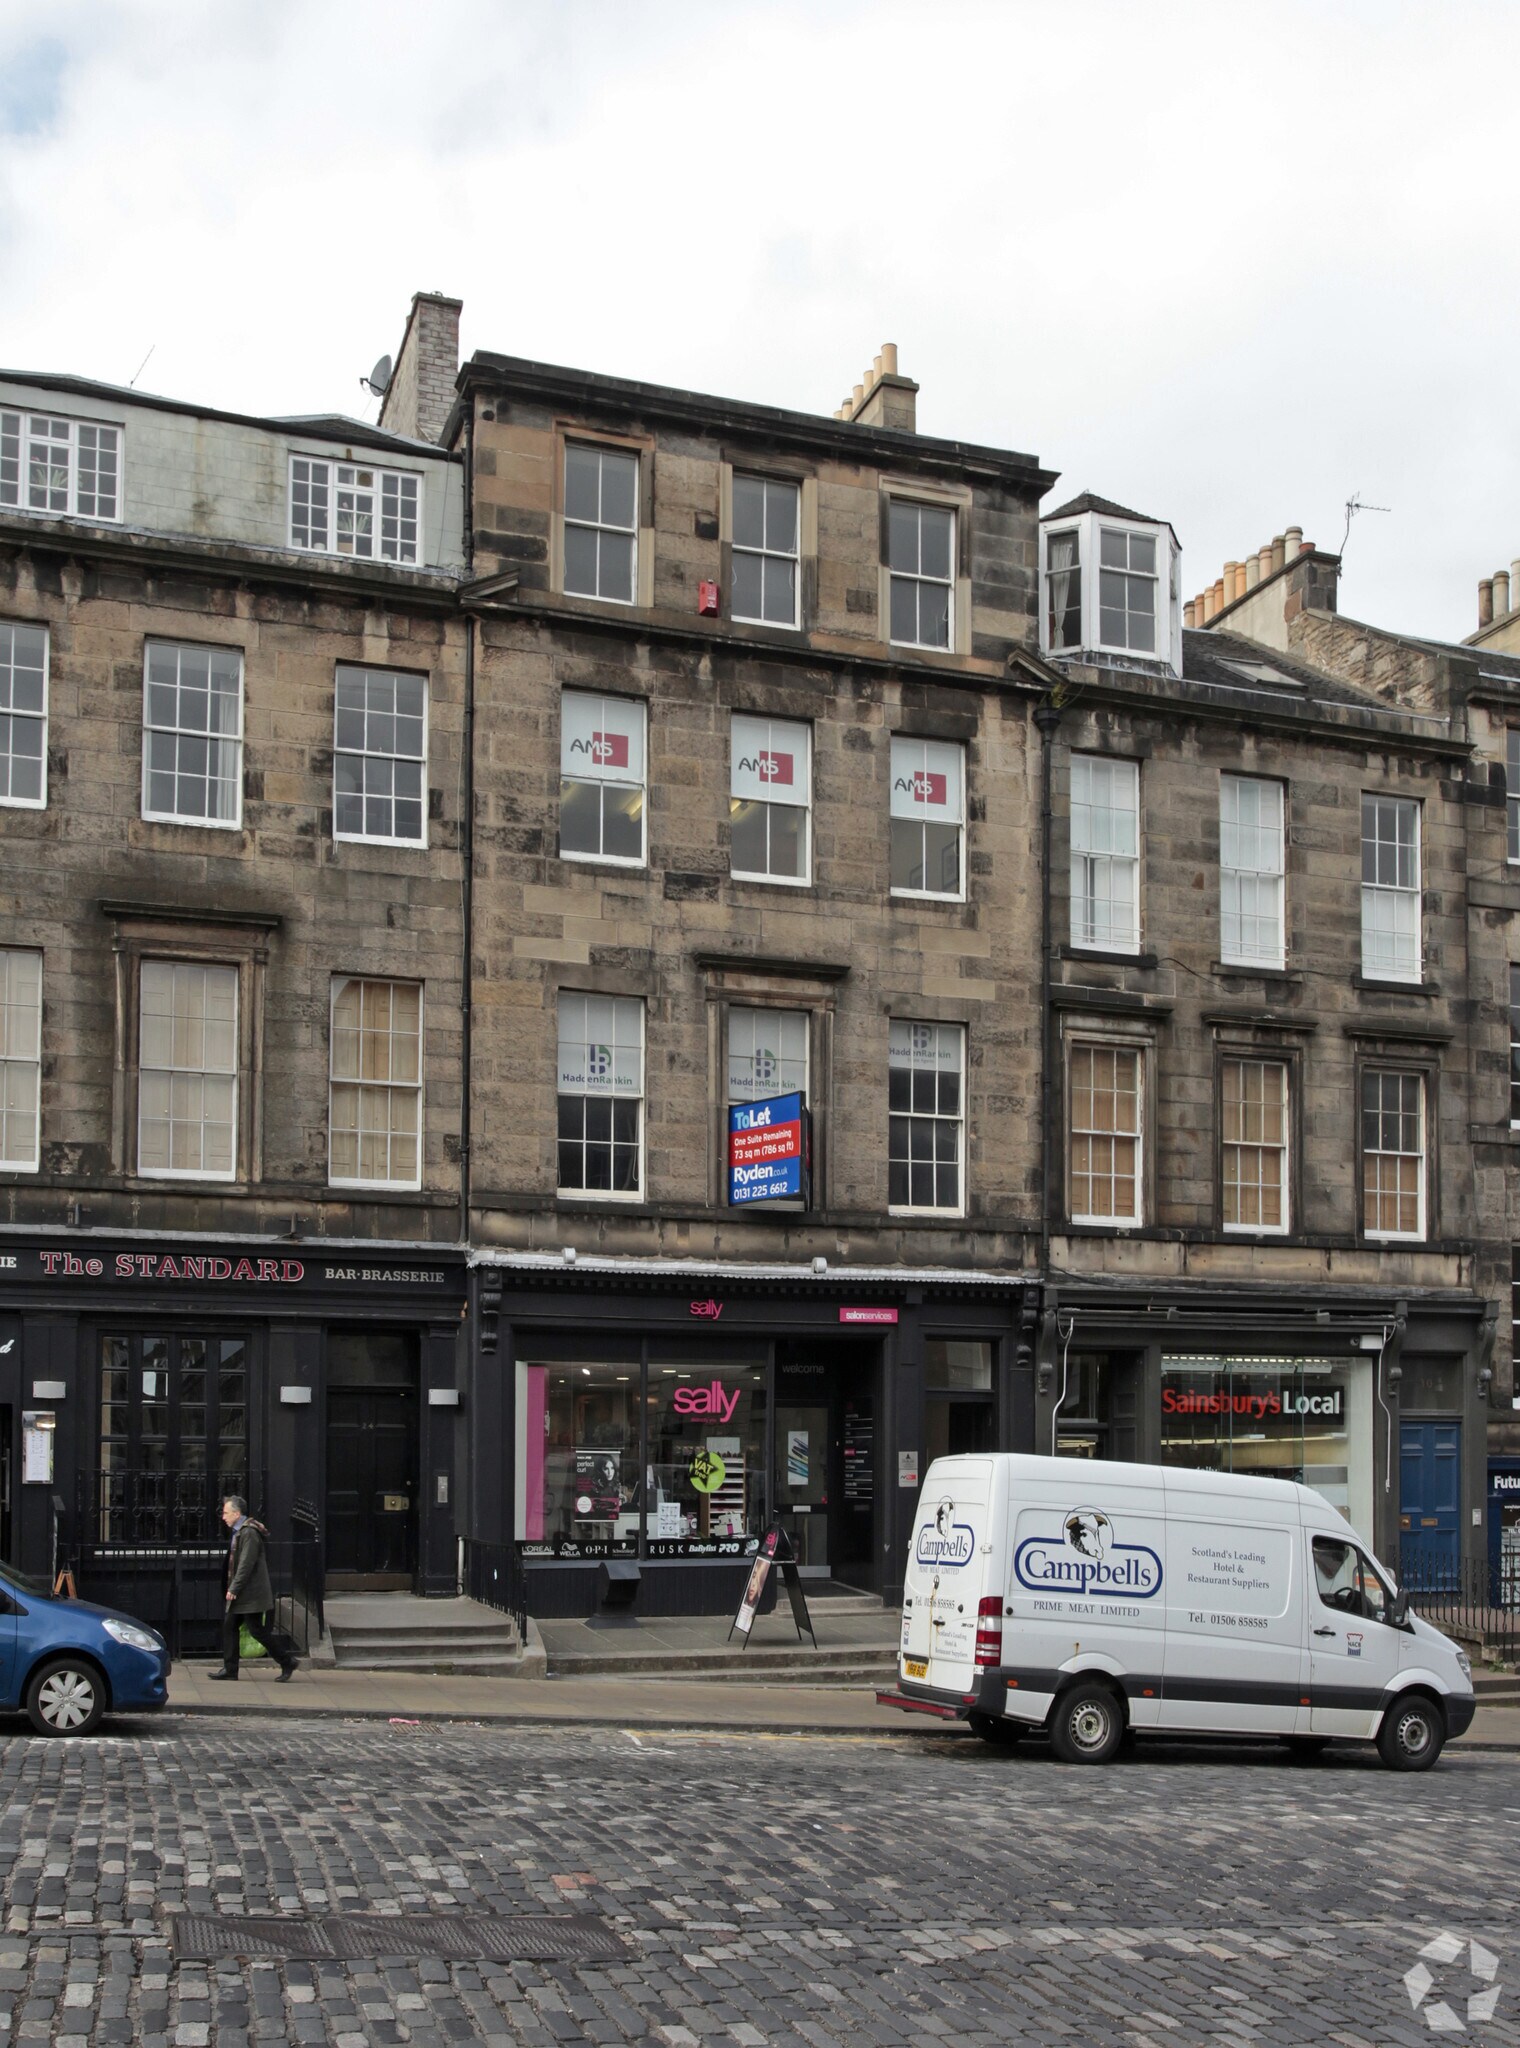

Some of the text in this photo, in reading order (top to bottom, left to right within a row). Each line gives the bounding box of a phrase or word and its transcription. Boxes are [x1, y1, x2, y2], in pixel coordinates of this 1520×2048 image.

[570, 738, 613, 757] AMS
[738, 757, 779, 775] AMS
[894, 777, 933, 795] AMS
[734, 1129, 792, 1147] One Suite Remaining
[734, 1141, 794, 1160] 73 sq m (786 sq ft)
[733, 1181, 788, 1200] 0131 225 6612
[40, 1251, 305, 1283] The STANDARD
[689, 1299, 723, 1320] sally
[782, 1363, 824, 1374] welcome
[674, 1381, 740, 1423] sally
[1162, 1389, 1340, 1419] Sainsbury's Local
[694, 1458, 714, 1475] VAT
[719, 1543, 739, 1553] PRO
[920, 1533, 968, 1561] Campbells
[1192, 1547, 1266, 1564] Scotland's Leading
[941, 1567, 960, 1575] LIMITED
[1025, 1550, 1151, 1588] Campbells
[1213, 1562, 1244, 1574] Hotel &
[1187, 1573, 1270, 1590] Restaurant Suppliers
[938, 1598, 955, 1609] 858585
[1033, 1600, 1140, 1617] PRIME MEAT LIMITED
[1188, 1612, 1268, 1629] Tel. 01506 858585
